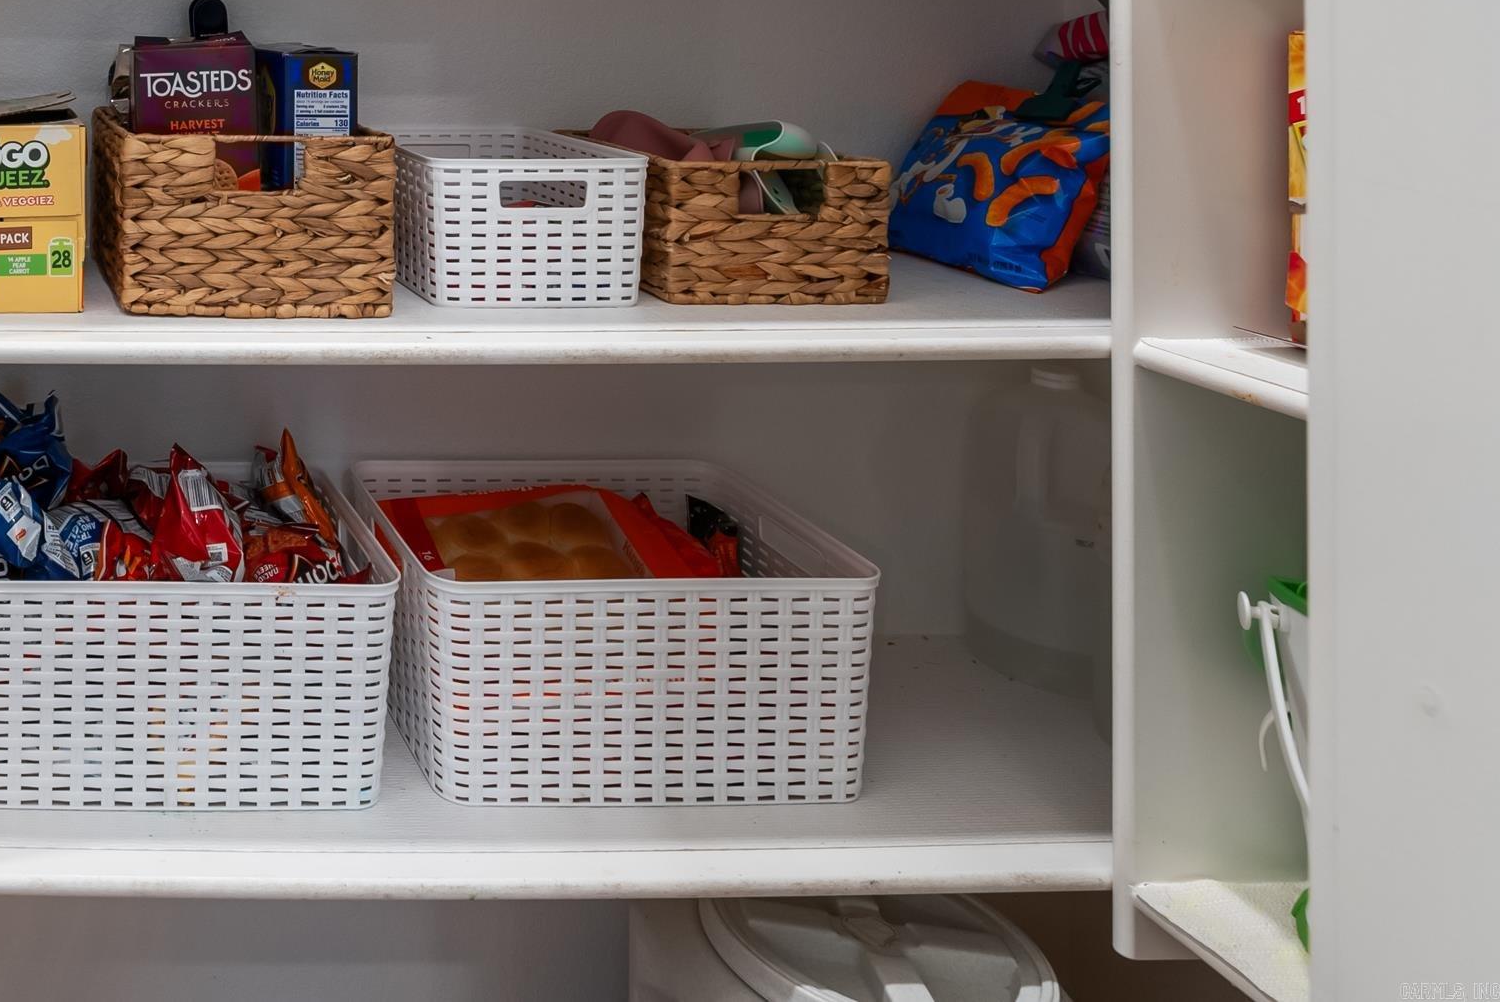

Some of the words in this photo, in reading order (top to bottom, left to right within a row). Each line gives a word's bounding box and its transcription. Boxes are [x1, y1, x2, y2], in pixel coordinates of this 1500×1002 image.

[311, 68, 334, 76] Honey
[139, 68, 252, 98] TOASTEDS
[164, 98, 230, 109] CRACKERS
[170, 118, 226, 131] HARVEST
[334, 119, 349, 127] 130
[3, 196, 55, 207] VEGGIEZ
[0, 233, 30, 244] PACK
[51, 250, 71, 269] 28
